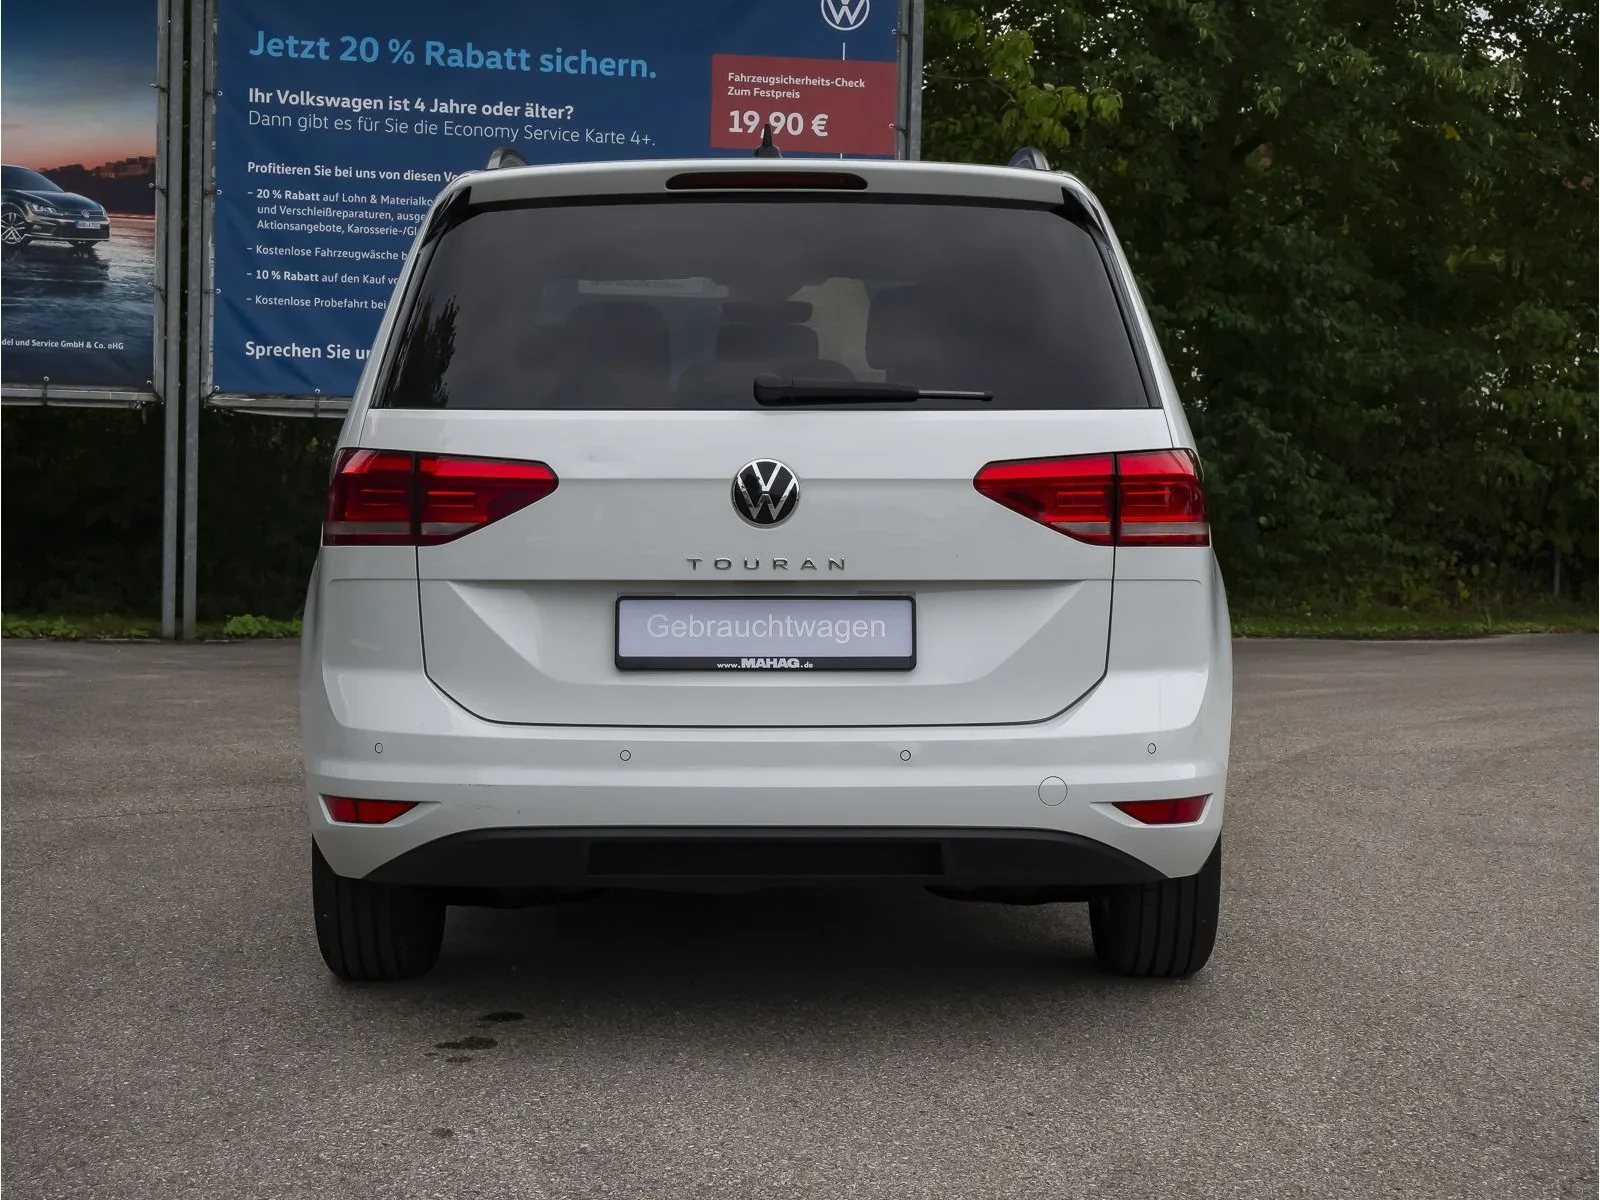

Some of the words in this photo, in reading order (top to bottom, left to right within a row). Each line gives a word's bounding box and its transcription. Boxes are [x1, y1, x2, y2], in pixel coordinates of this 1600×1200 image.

[249, 31, 329, 60] Jetzt
[340, 36, 378, 62] 20
[389, 39, 414, 64] %
[426, 41, 531, 71] Rabatt
[540, 48, 656, 78] sichern.
[728, 73, 865, 89] Fahrzeugsicherheits-Check
[728, 87, 750, 96] Zum
[754, 88, 800, 99] Festpreis
[250, 88, 272, 103] Ihr
[277, 90, 383, 112] Volkswagen
[389, 96, 410, 111] ist
[415, 98, 425, 111] 4
[430, 99, 477, 114] Jahre
[482, 102, 521, 116] oder
[525, 103, 573, 119] älter?
[249, 111, 291, 126] Dann
[298, 114, 328, 131] gibt
[335, 119, 351, 130] es
[358, 116, 379, 131] für
[385, 118, 408, 133] Sie
[414, 120, 437, 134] die
[445, 121, 519, 142] Economy
[525, 125, 579, 142] Service
[586, 129, 625, 144] Karte
[631, 131, 655, 146] 4+.
[811, 114, 828, 136] €
[248, 162, 310, 175] Profitieren
[315, 165, 331, 176] Sie
[335, 166, 352, 177] bei
[356, 170, 376, 178] uns
[379, 171, 400, 179] von
[404, 170, 440, 181] diesen
[257, 189, 269, 198] 20
[273, 190, 282, 199] %
[285, 190, 320, 201] Rabatt
[323, 193, 339, 201] auf
[343, 193, 366, 203] Lohn
[370, 195, 377, 204] &
[258, 205, 276, 214] und
[280, 206, 393, 221] Verschleißreparaturen,
[257, 220, 344, 234] Aktionsangebote,
[257, 245, 311, 256] Kostenlose
[315, 248, 398, 260] Fahrzeugwäsche
[257, 270, 268, 279] 10
[272, 271, 281, 280] %
[284, 271, 318, 281] Rabatt
[322, 273, 338, 282] auf
[341, 274, 359, 283] den
[363, 275, 385, 284] Kauf
[256, 295, 310, 306] Kostenlose
[314, 298, 368, 308] Probefahrt
[371, 300, 387, 309] bei
[246, 341, 321, 359] Sprechen
[327, 344, 350, 359] Sie
[687, 557, 845, 570] TOURAN
[647, 613, 886, 643] Gebrauchtwagen
[717, 657, 814, 669] www.MAHAG.de
